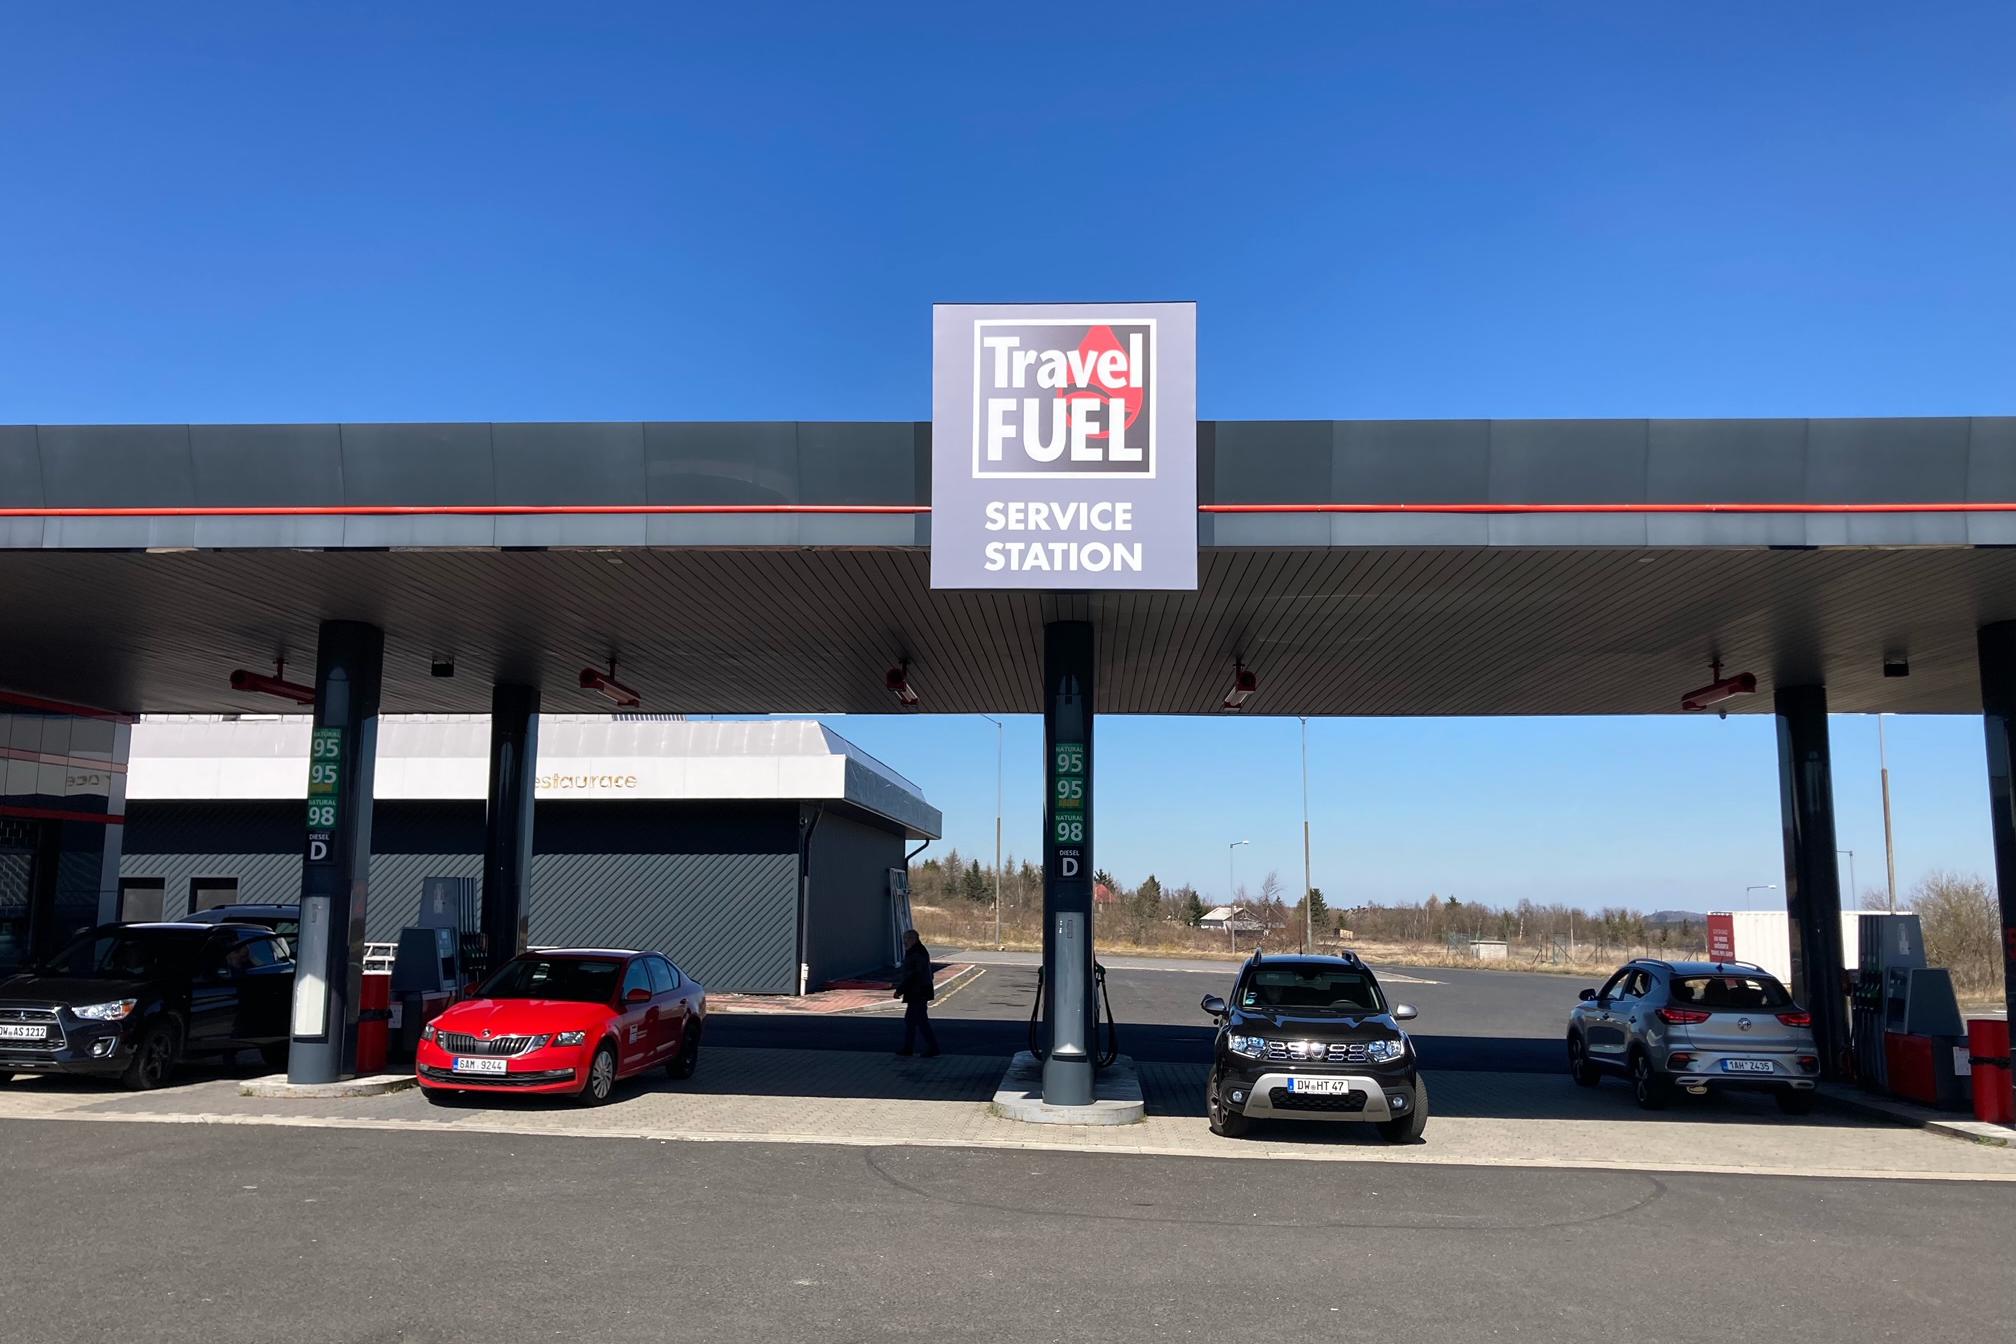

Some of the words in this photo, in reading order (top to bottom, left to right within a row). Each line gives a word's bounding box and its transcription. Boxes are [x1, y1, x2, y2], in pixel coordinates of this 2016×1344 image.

[983, 333, 1143, 389] Travel
[987, 397, 1143, 462] FUEL
[984, 501, 1132, 531] SERVICE
[984, 541, 1142, 571] STATION
[313, 738, 339, 757] 95
[1057, 754, 1082, 773] 95
[311, 765, 337, 784] 95
[1057, 780, 1082, 799] 95
[308, 807, 334, 826] 98
[1057, 822, 1083, 841] 98
[310, 841, 327, 860] D
[1062, 857, 1079, 876] D
[13, 1027, 24, 1037] AS
[25, 1027, 46, 1037] 1212
[481, 1060, 502, 1070] 9244
[1297, 1080, 1311, 1090] DW
[1316, 1081, 1329, 1091] HT
[1332, 1081, 1344, 1091] 47
